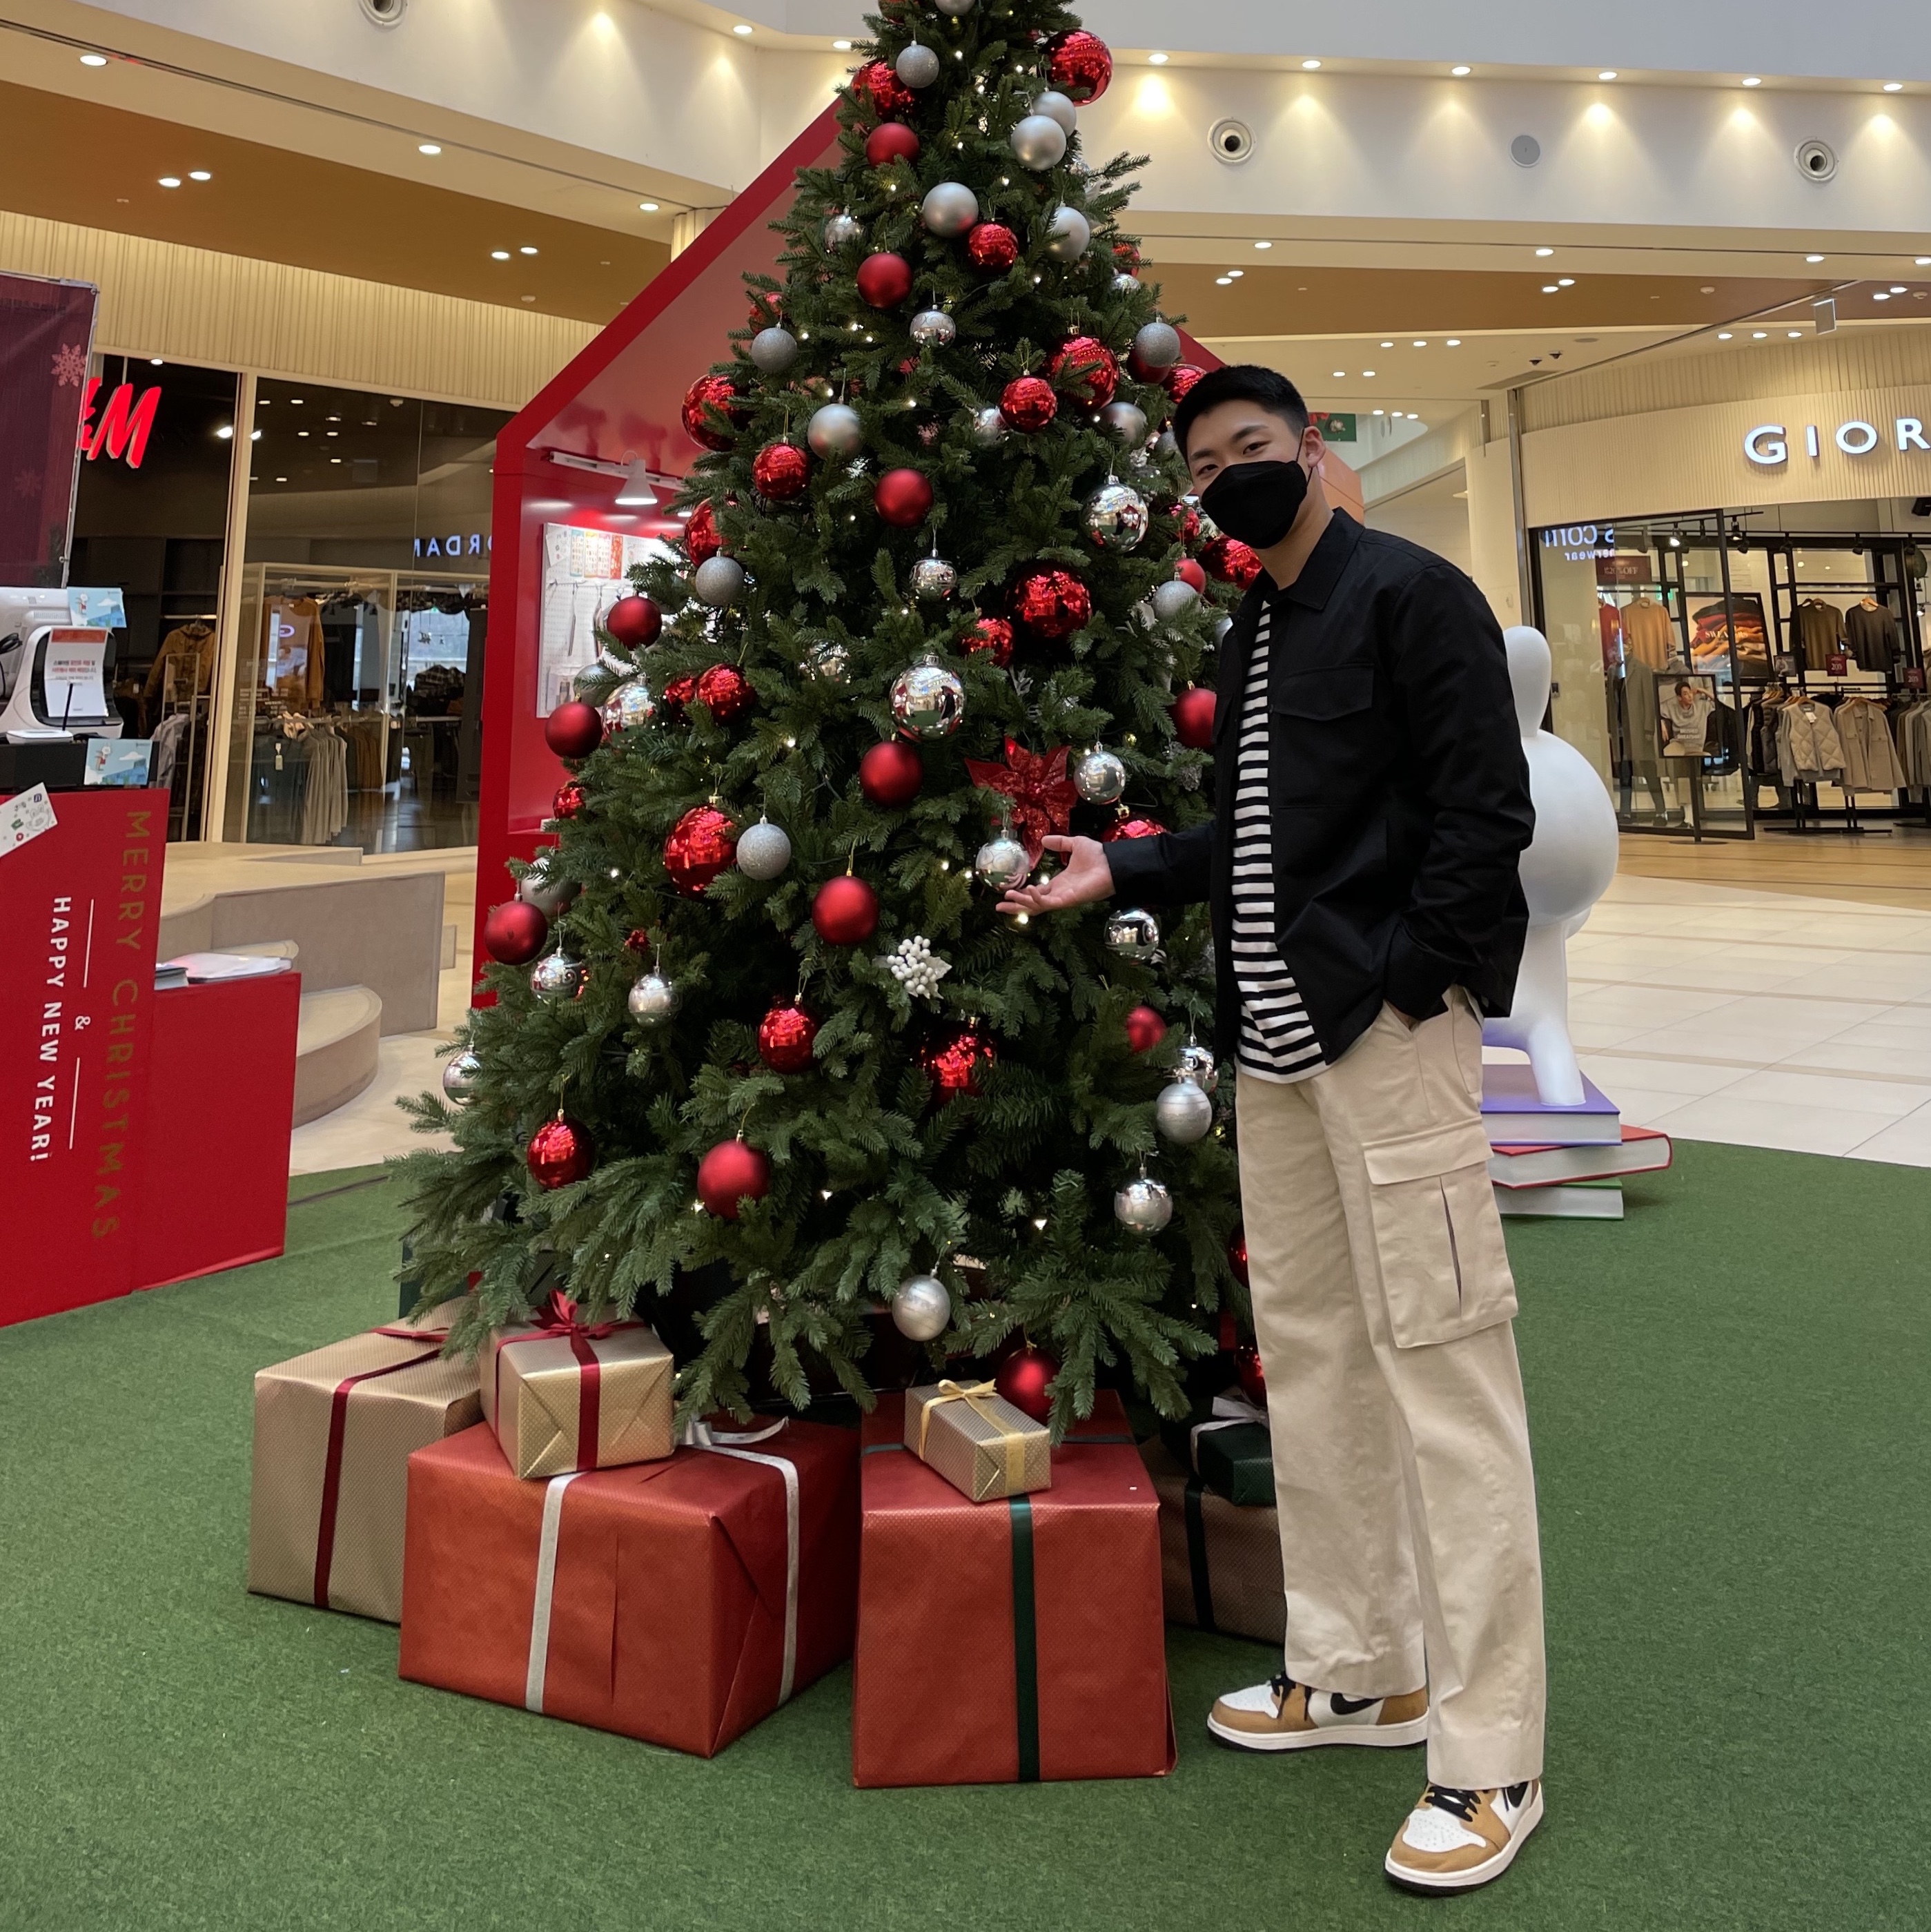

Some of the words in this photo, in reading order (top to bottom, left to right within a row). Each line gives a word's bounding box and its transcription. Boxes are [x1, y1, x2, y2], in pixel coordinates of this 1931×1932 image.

[1744, 417, 1931, 465] GIOR
[116, 811, 151, 950] MERRY
[46, 897, 71, 987] HAPPY
[39, 1002, 62, 1062] NEW
[75, 1015, 91, 1031] &
[30, 1075, 55, 1162] YEAR!
[92, 979, 138, 1238] CHRISTMAS
